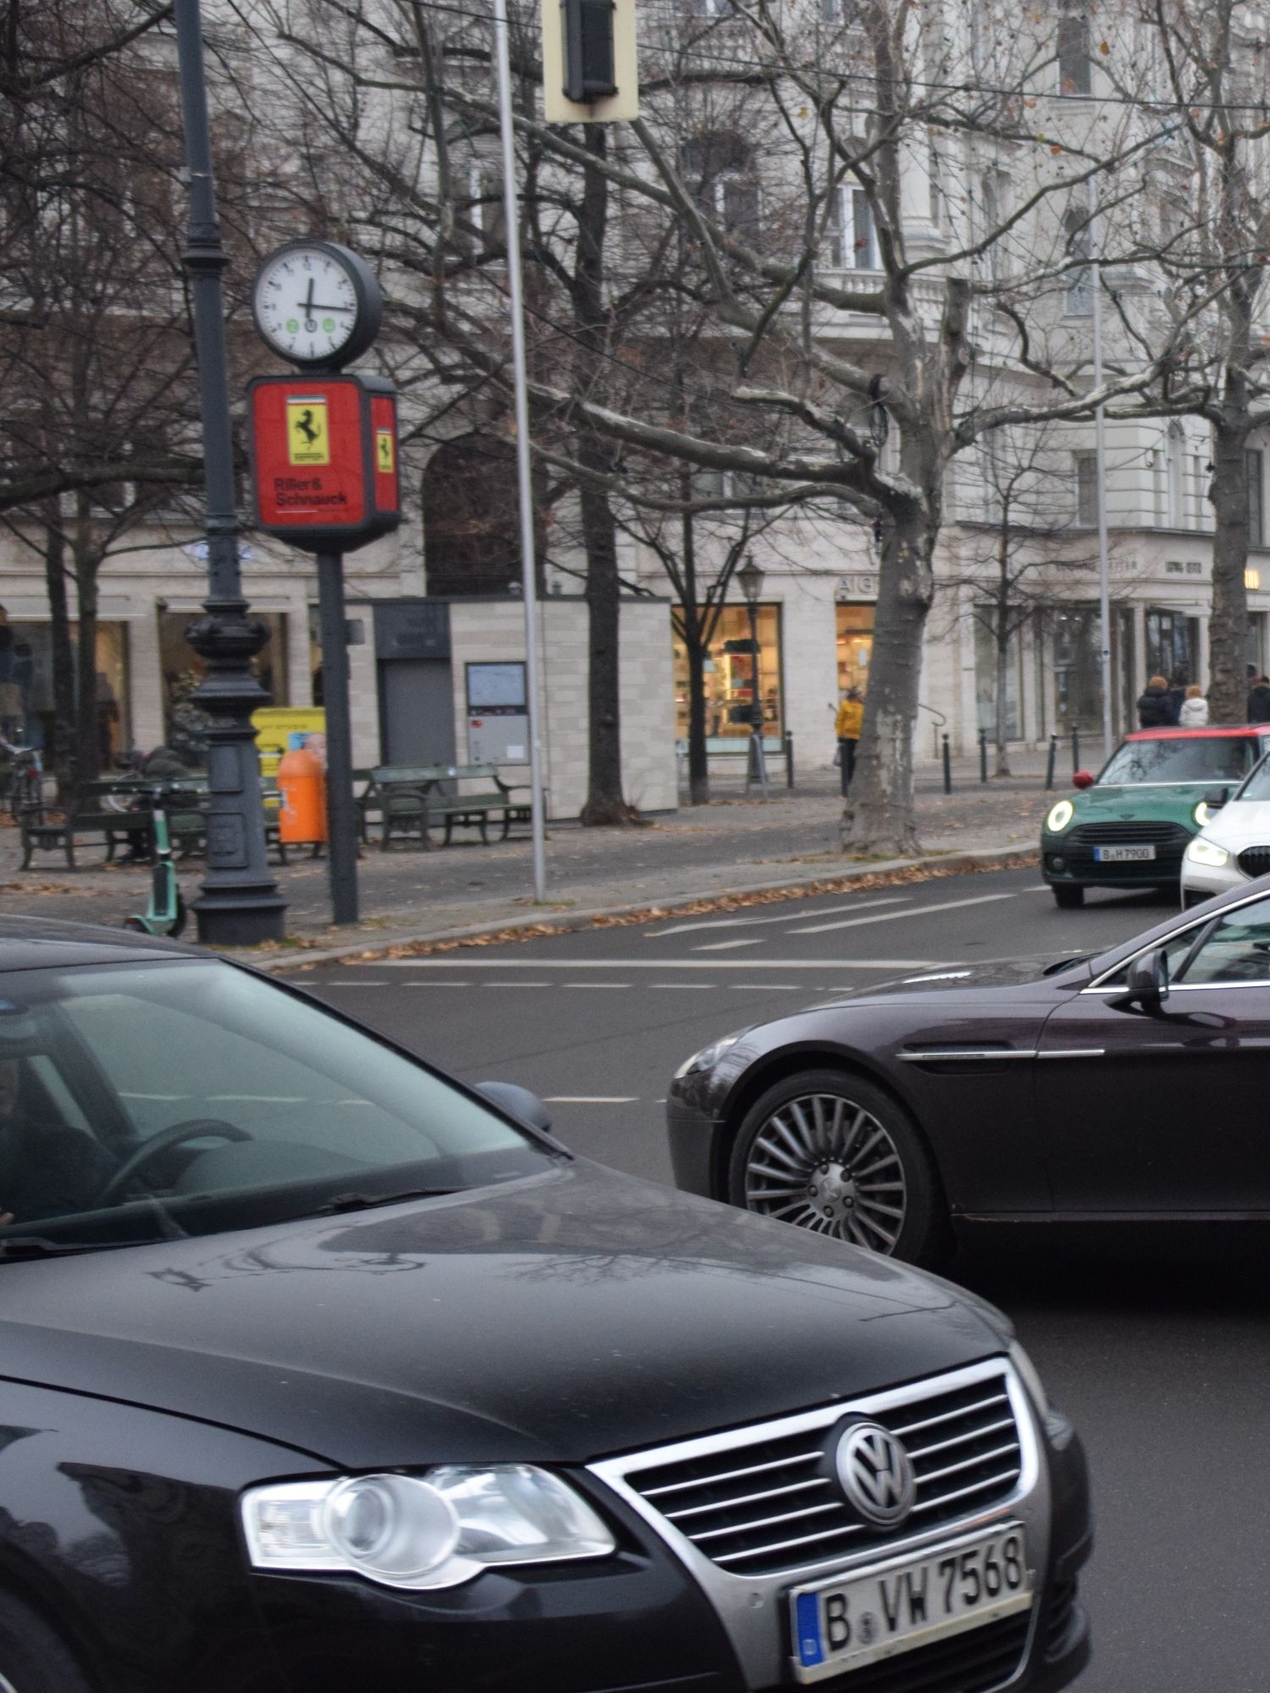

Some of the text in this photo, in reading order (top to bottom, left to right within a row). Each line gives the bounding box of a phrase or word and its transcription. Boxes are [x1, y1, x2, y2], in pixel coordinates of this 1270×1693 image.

[825, 1593, 850, 1652] B
[878, 1566, 928, 1632] VW
[938, 1536, 1022, 1614] 7568
